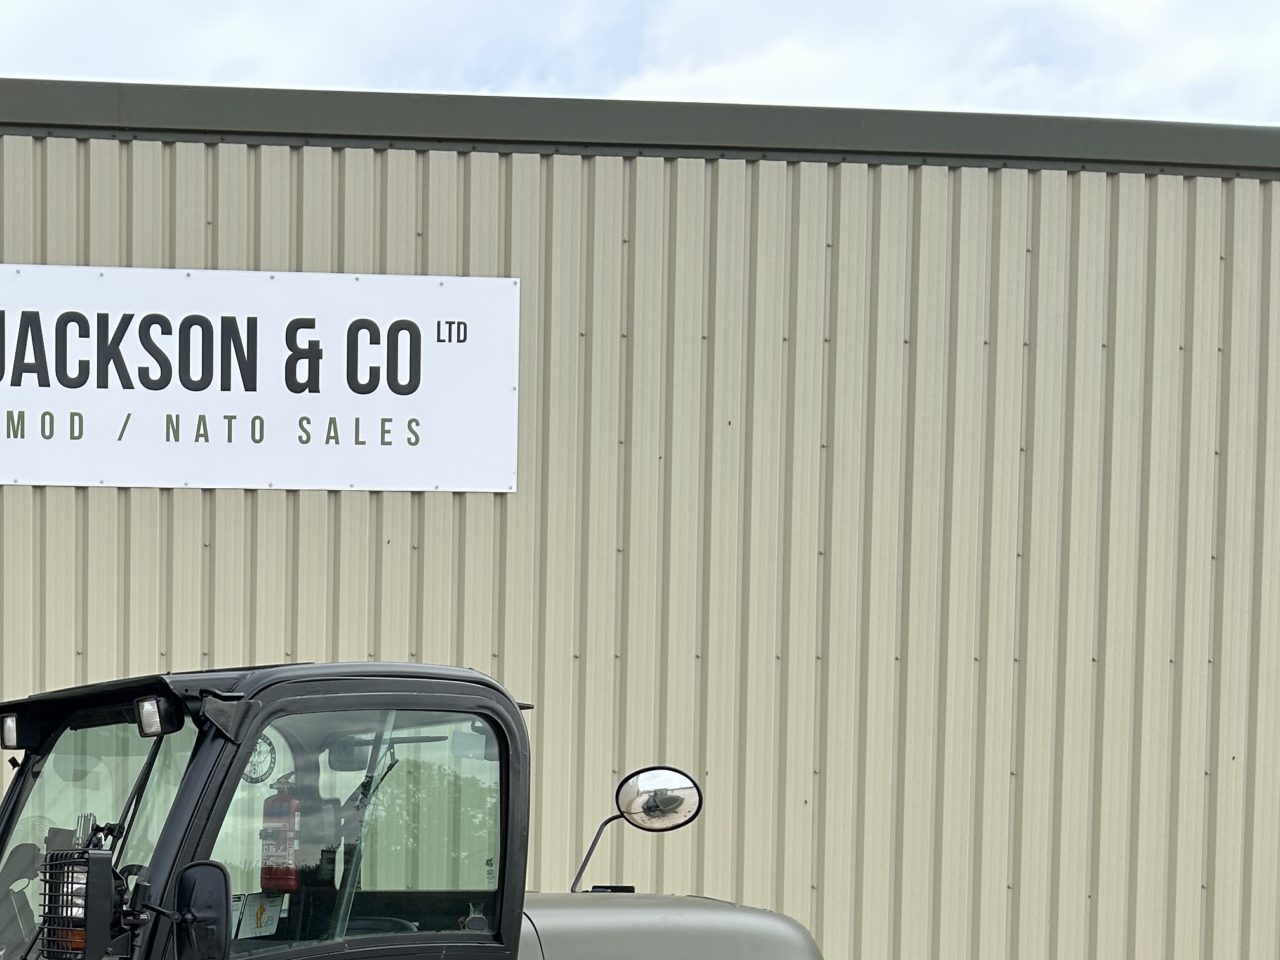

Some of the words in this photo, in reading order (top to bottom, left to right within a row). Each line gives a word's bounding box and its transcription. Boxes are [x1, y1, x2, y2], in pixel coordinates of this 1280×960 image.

[284, 317, 324, 395] &
[346, 318, 422, 396] CO
[436, 320, 468, 344] LTD
[6, 410, 84, 441] MOD
[117, 413, 132, 442] /
[165, 413, 265, 444] NATO
[297, 415, 420, 447] SALES
